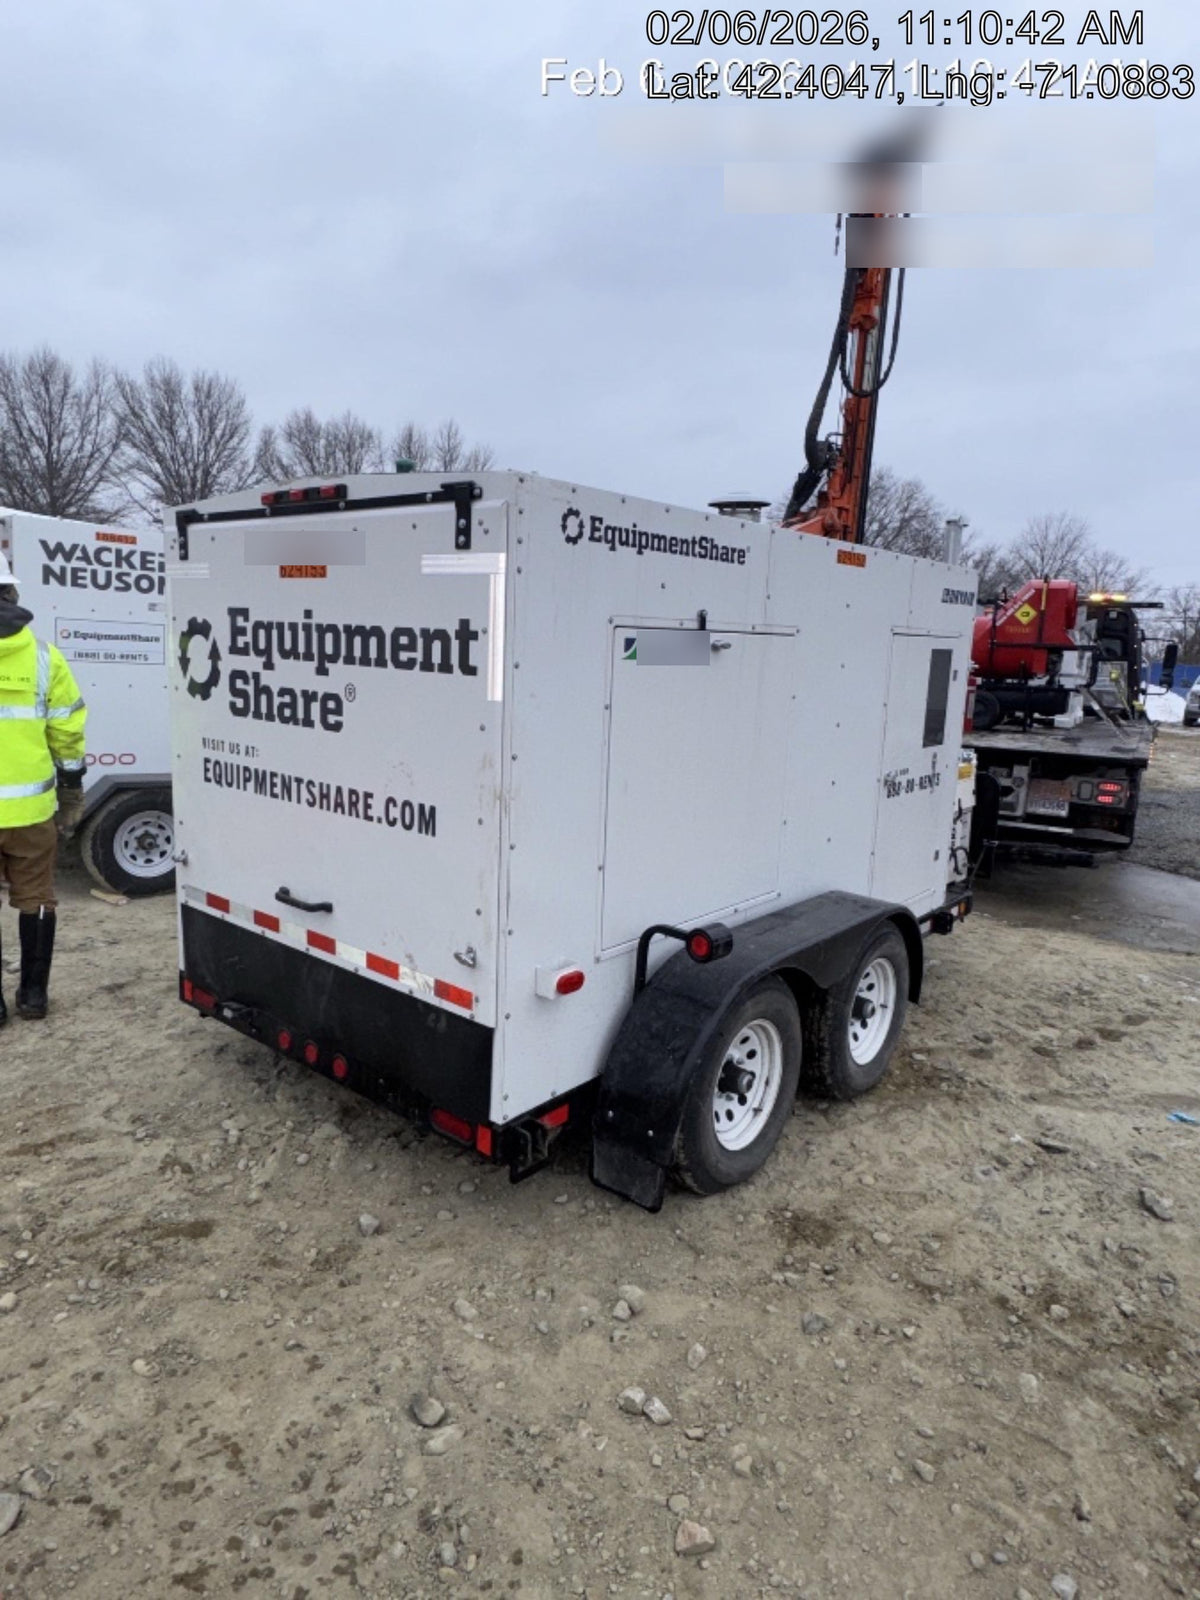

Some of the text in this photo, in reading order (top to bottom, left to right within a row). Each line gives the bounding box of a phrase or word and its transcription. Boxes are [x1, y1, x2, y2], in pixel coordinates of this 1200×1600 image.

[588, 514, 747, 566] EquipmentShare
[73, 630, 161, 643] EquipmentShare
[227, 607, 479, 677] Equipment
[228, 742, 241, 756] US
[203, 757, 437, 837] EQUIPMENTSHARE.COM
